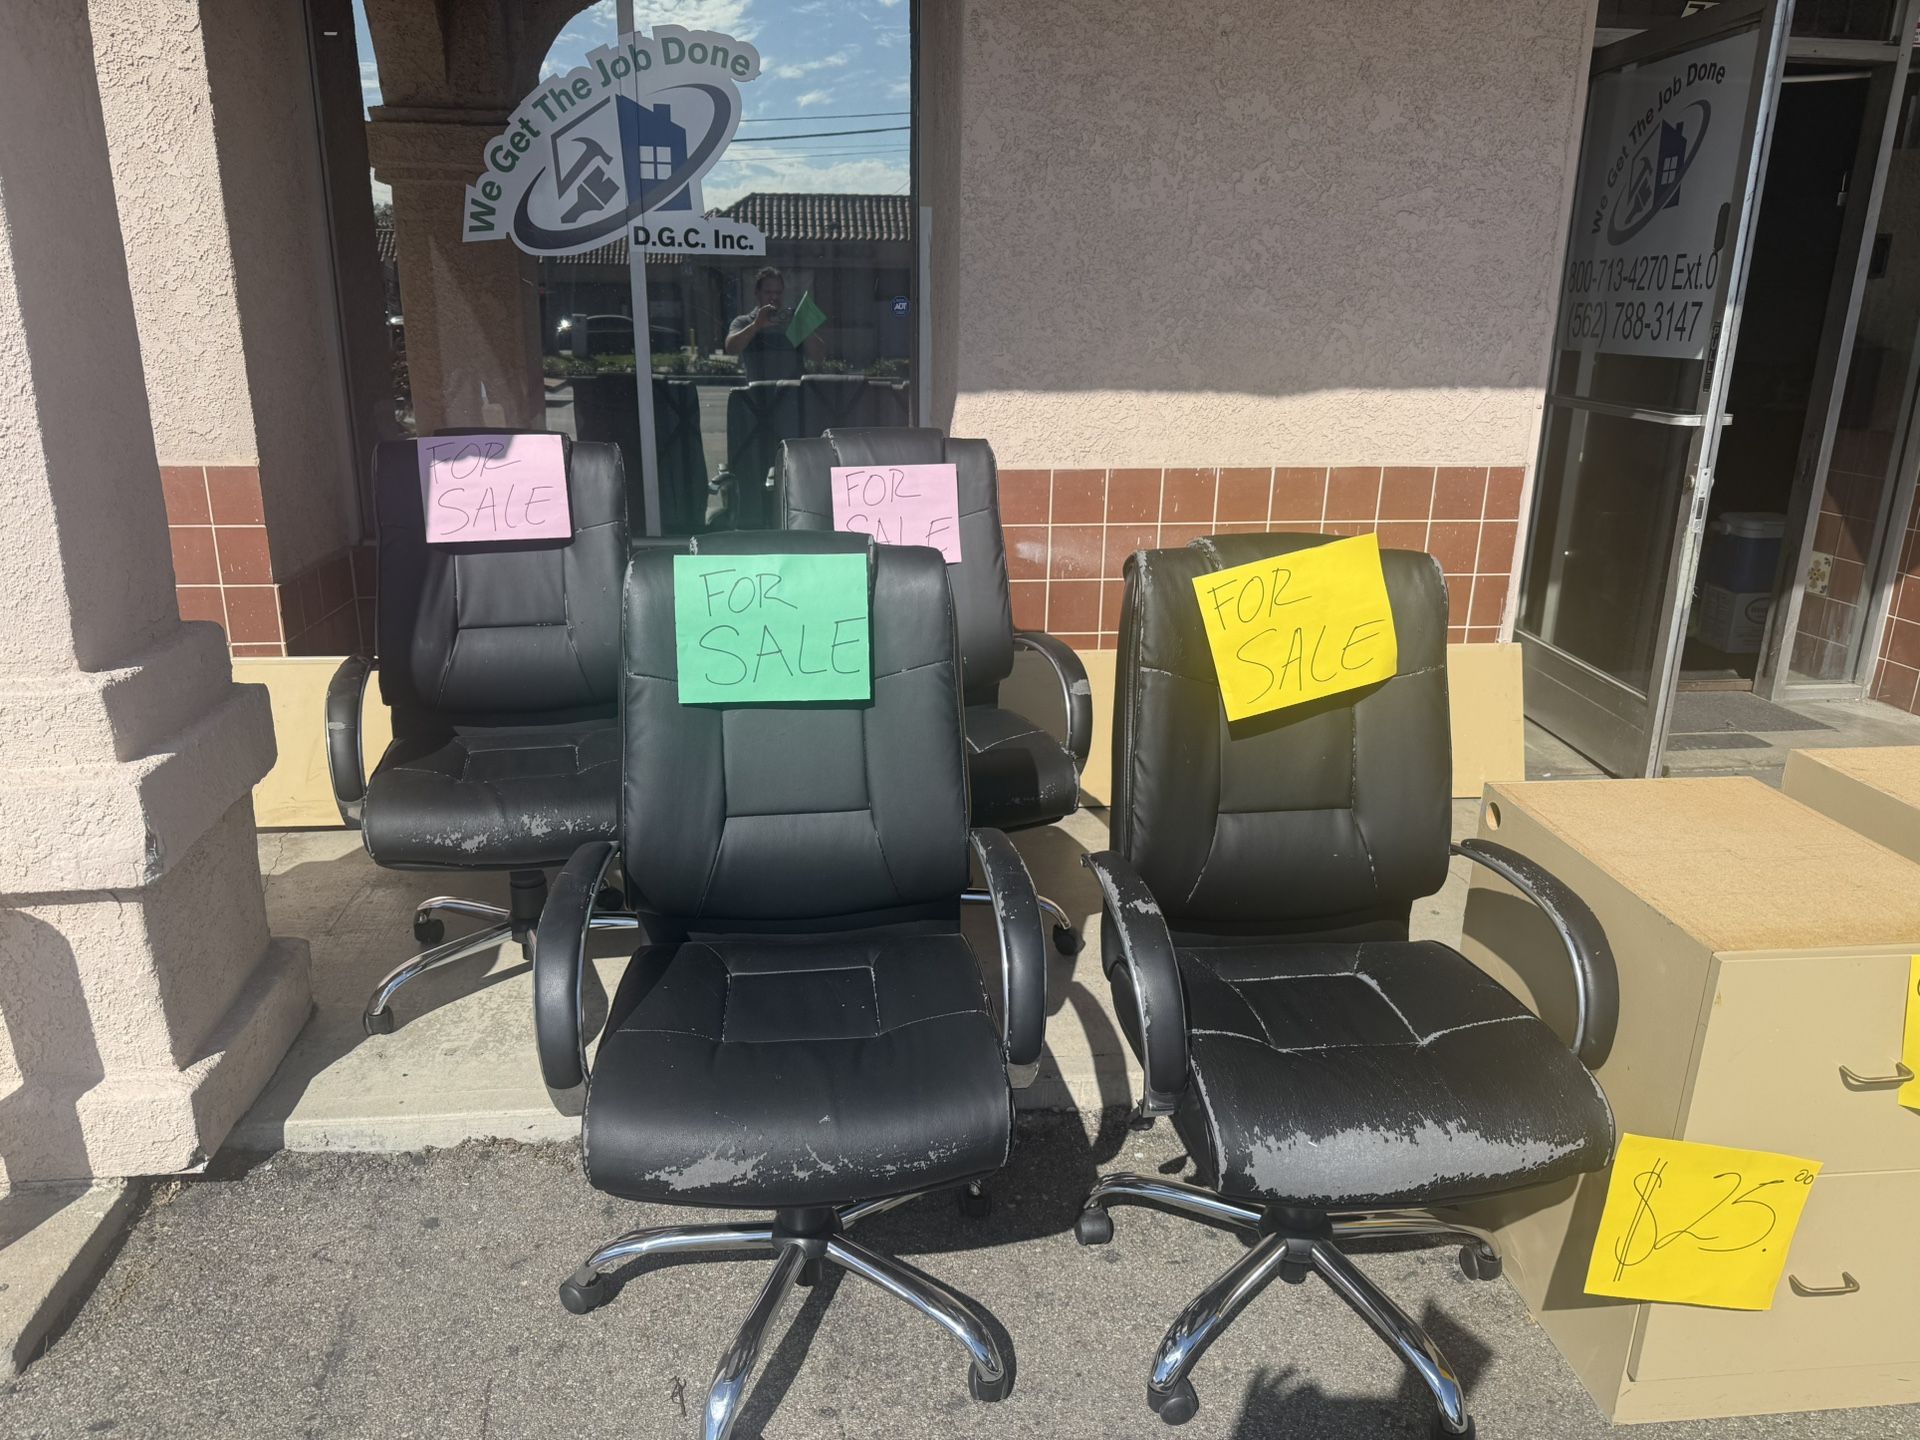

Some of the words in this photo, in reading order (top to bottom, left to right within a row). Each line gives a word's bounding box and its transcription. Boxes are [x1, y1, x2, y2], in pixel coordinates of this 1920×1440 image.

[469, 180, 502, 233] We
[490, 117, 541, 173] Get
[532, 77, 592, 122] The
[595, 44, 651, 88] Job
[661, 36, 751, 76] Done
[1591, 195, 1608, 235] We
[1607, 146, 1630, 188] Get
[1628, 108, 1654, 144] The
[1658, 78, 1682, 112] Job
[1686, 62, 1726, 87] Done
[633, 226, 706, 249] D.G.C.
[714, 229, 754, 250] Inc.
[1568, 254, 1669, 294] 800-713-4270
[894, 302, 907, 311] ADT
[1567, 301, 1608, 349] (562)
[1612, 301, 1704, 342] 788-3147
[426, 442, 522, 484] FOR
[438, 484, 553, 535] SALE
[846, 469, 921, 507] FOR
[699, 568, 798, 616] FOR
[1207, 568, 1312, 630] FOR
[699, 616, 866, 685] SALE
[1236, 618, 1385, 704] SALE
